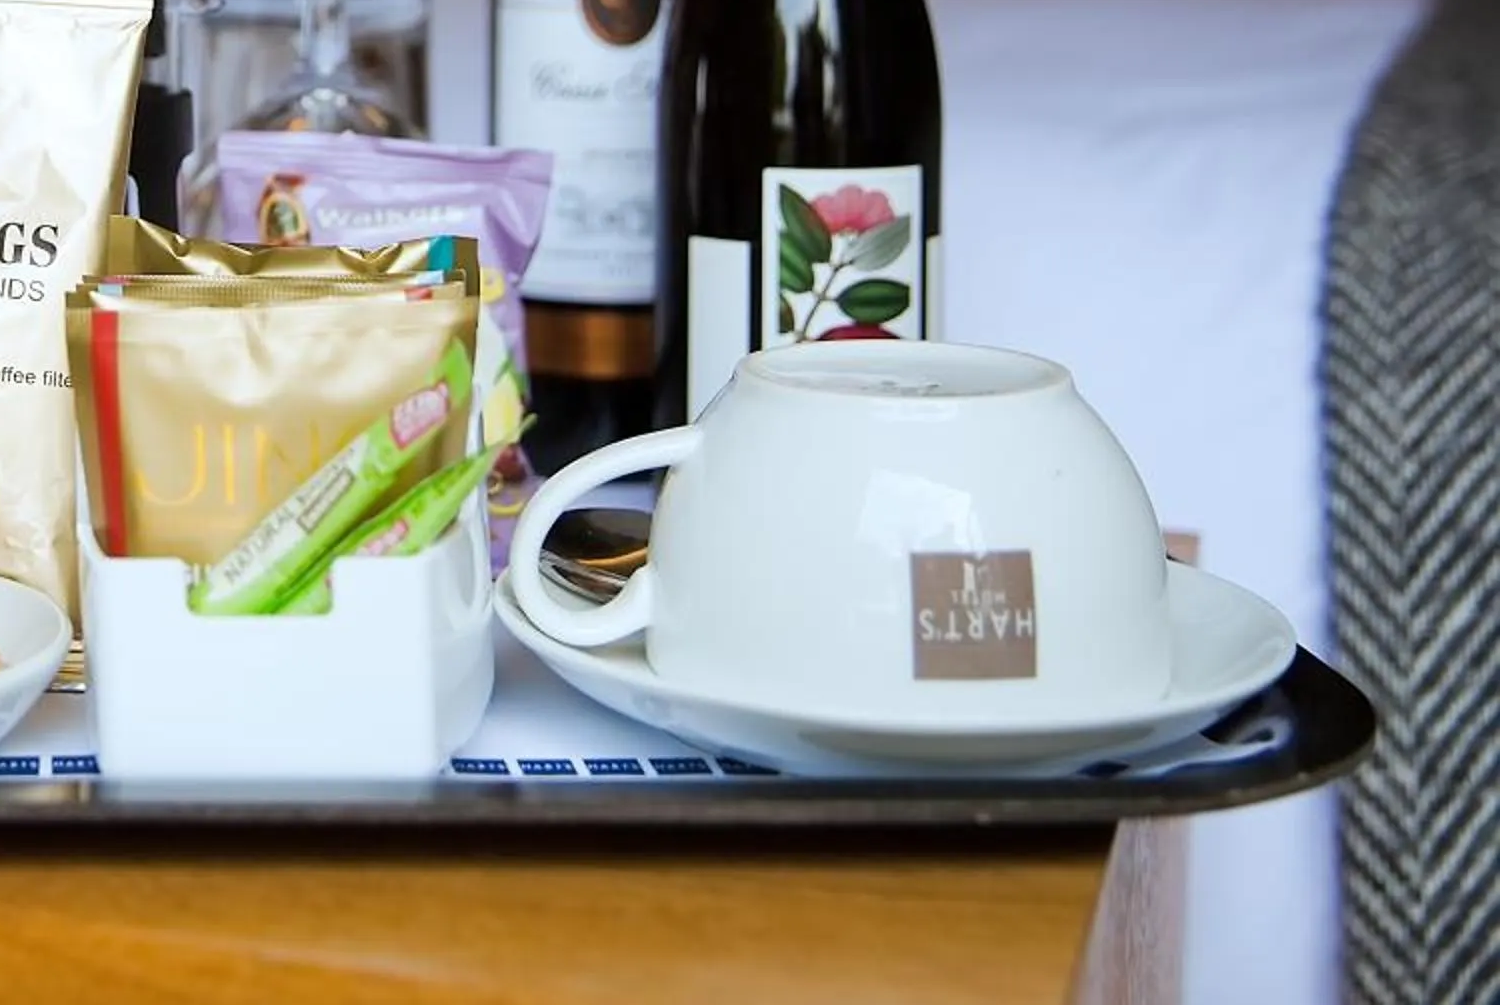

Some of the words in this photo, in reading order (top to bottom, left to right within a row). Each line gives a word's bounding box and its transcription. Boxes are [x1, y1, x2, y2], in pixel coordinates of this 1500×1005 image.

[42, 369, 74, 389] filte
[222, 502, 296, 585] NATURAL
[918, 606, 1033, 642] HART'S
